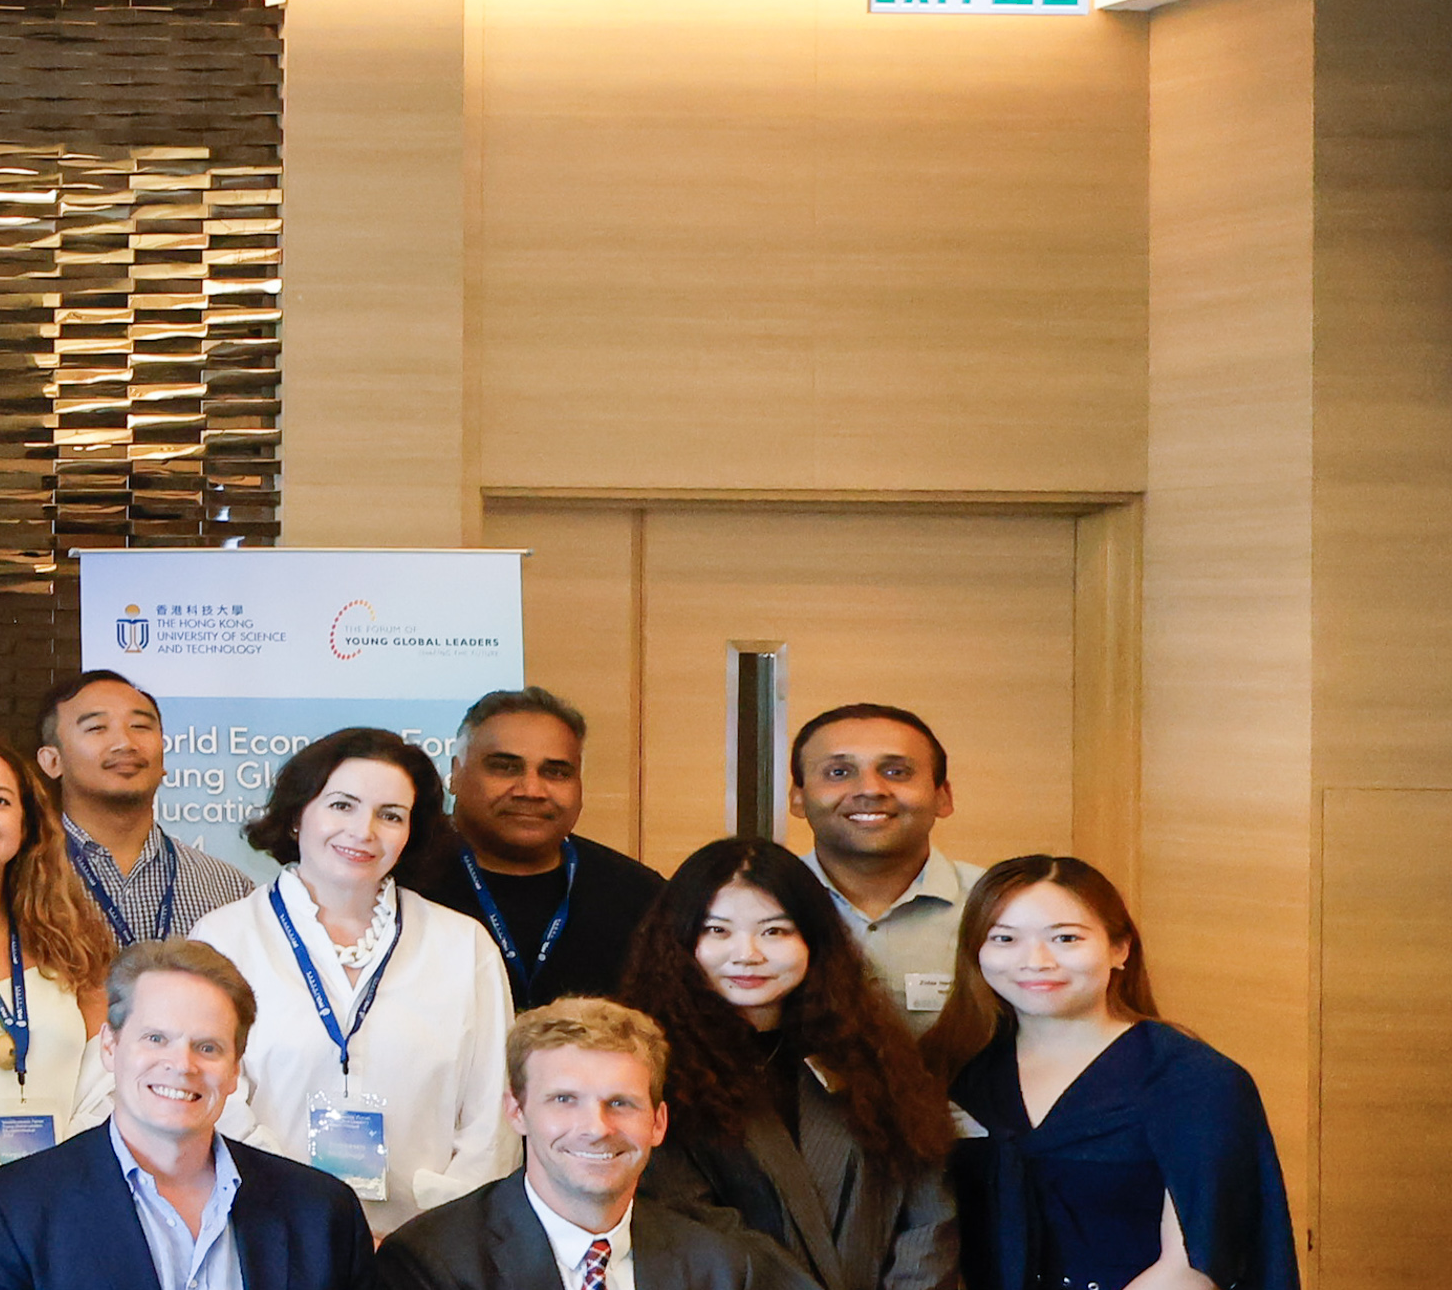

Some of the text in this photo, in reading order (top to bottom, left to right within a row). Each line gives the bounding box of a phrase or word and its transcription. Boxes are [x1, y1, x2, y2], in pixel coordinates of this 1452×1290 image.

[156, 604, 244, 616] 香港科技大學
[156, 618, 254, 629] THE HONG KONG
[156, 631, 287, 642] UNIVERSITY OF SCIENCE
[345, 637, 500, 647] YOUNG GLOBAL LEADERS
[157, 644, 262, 654] AND TECHNOLOGY
[162, 725, 457, 758] orld Econ For
[162, 767, 226, 795] ung
